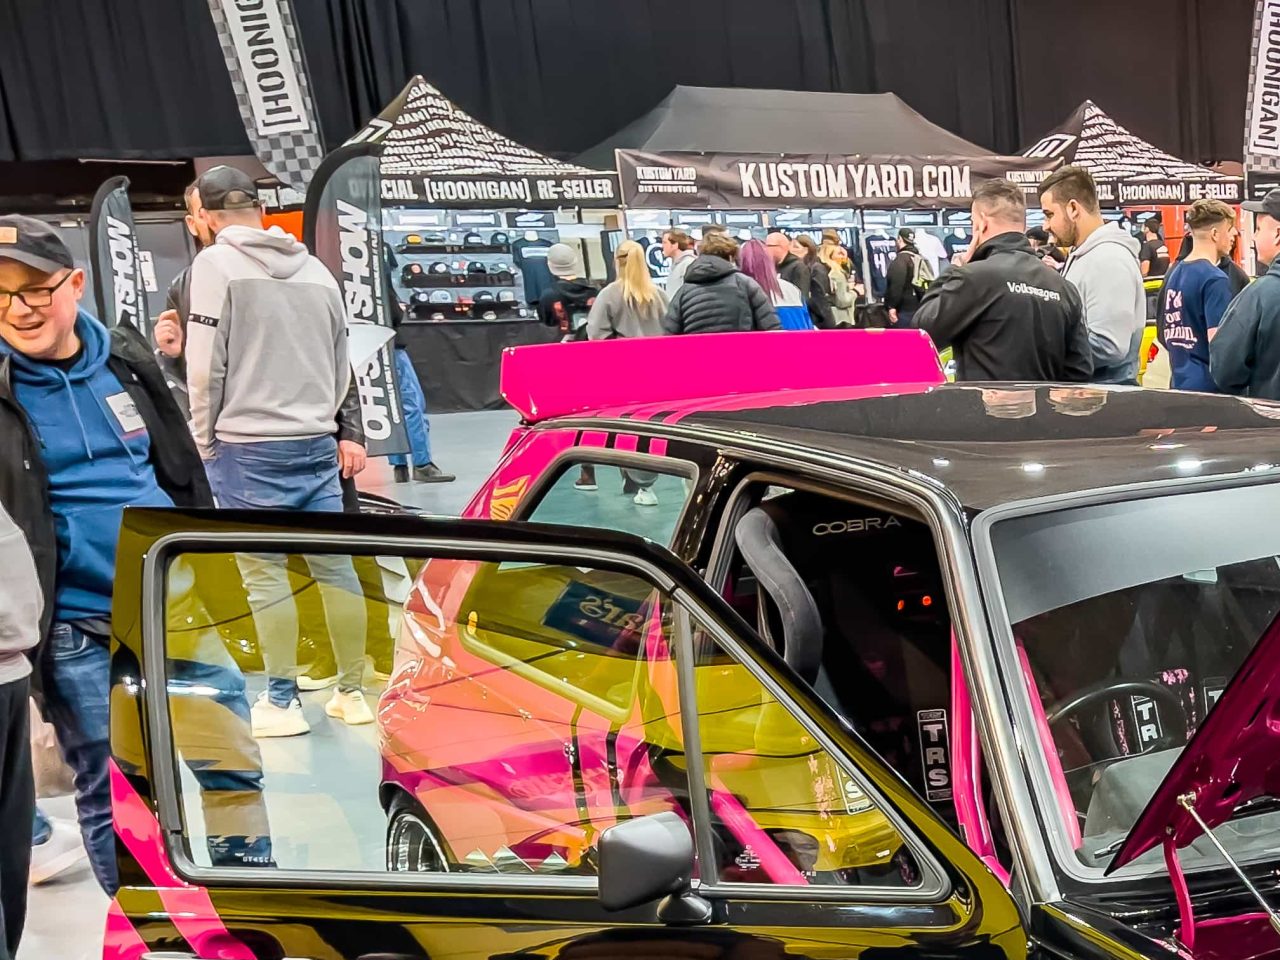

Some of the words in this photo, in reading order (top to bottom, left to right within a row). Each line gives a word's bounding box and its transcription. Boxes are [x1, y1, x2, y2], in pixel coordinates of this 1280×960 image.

[636, 166, 697, 180] KUSTOMYARD
[738, 162, 974, 198] KUSTOMYARD.COM
[424, 178, 531, 203] [HOONIGAN]
[537, 178, 615, 200] RE-SELLER
[638, 185, 698, 193] DISTRIBUTION
[1118, 183, 1185, 202] [HOONIGAN]
[1189, 183, 1239, 199] RE-SELLER
[1006, 281, 1060, 301] Volkswagen
[812, 516, 902, 535] COBRA
[922, 723, 949, 787] TRS
